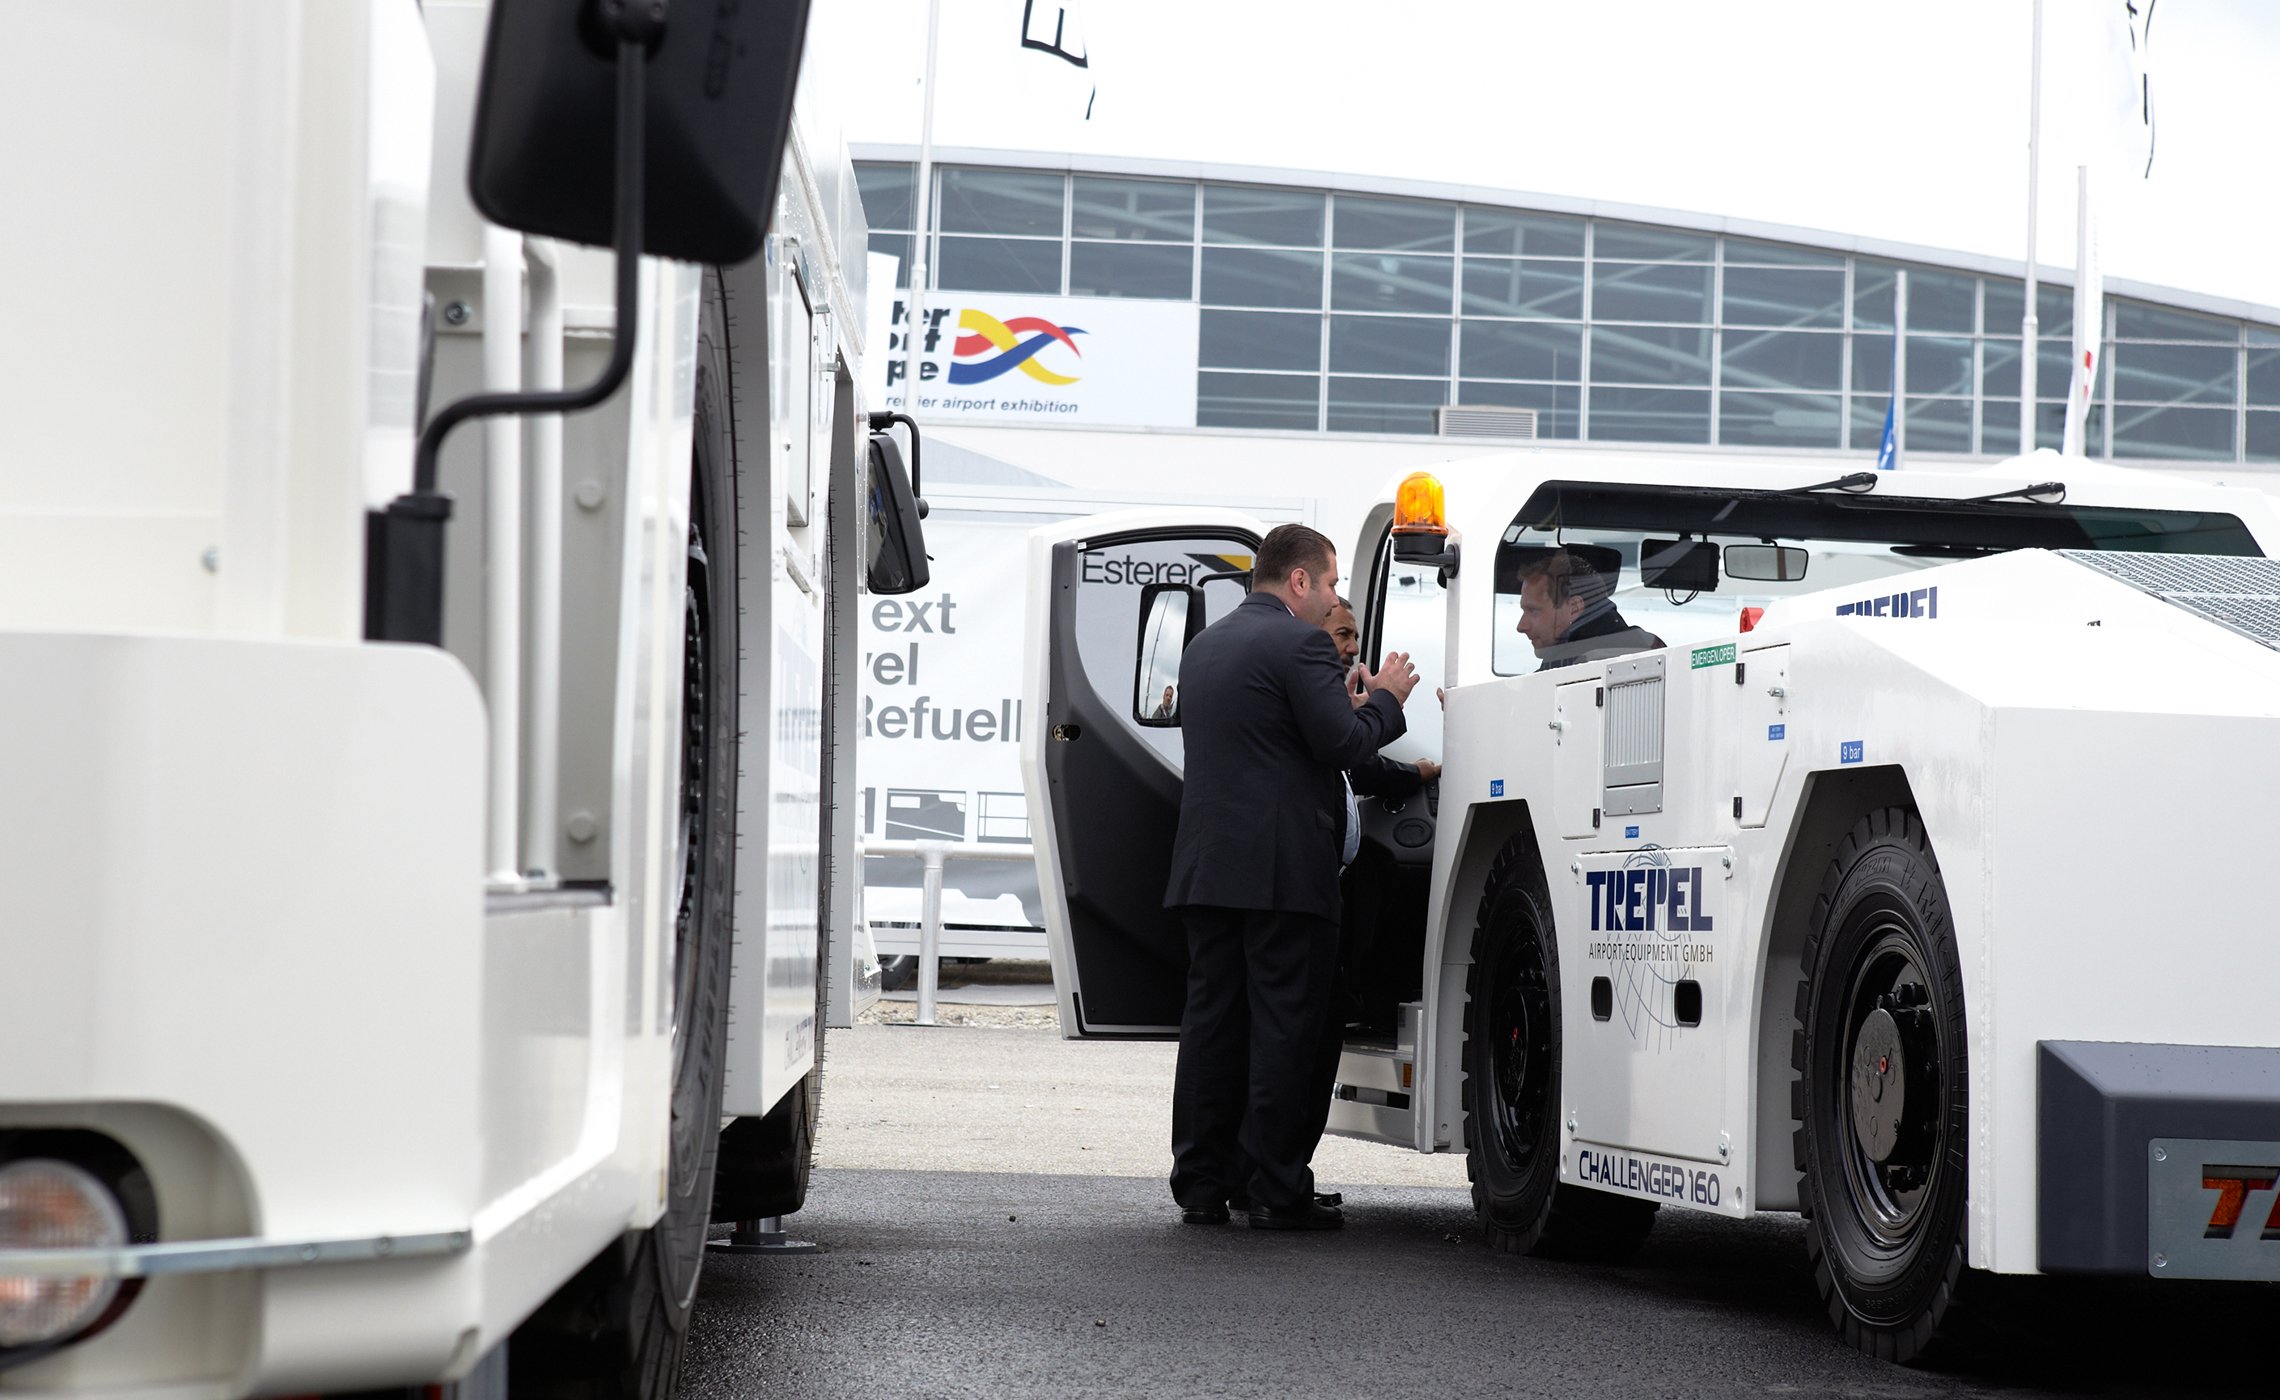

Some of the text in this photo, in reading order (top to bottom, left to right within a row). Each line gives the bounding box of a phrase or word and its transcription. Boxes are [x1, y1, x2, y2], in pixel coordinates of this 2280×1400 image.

[886, 395, 1079, 414] reier airport exhibition
[1082, 551, 1202, 586] Esterer
[1849, 745, 1861, 760] bar
[1586, 867, 1713, 931] TREPEL
[1588, 943, 1713, 963] AIRPORT EQUIPMENT GMBH
[1579, 1150, 1721, 1207] CHALLENGER 160
